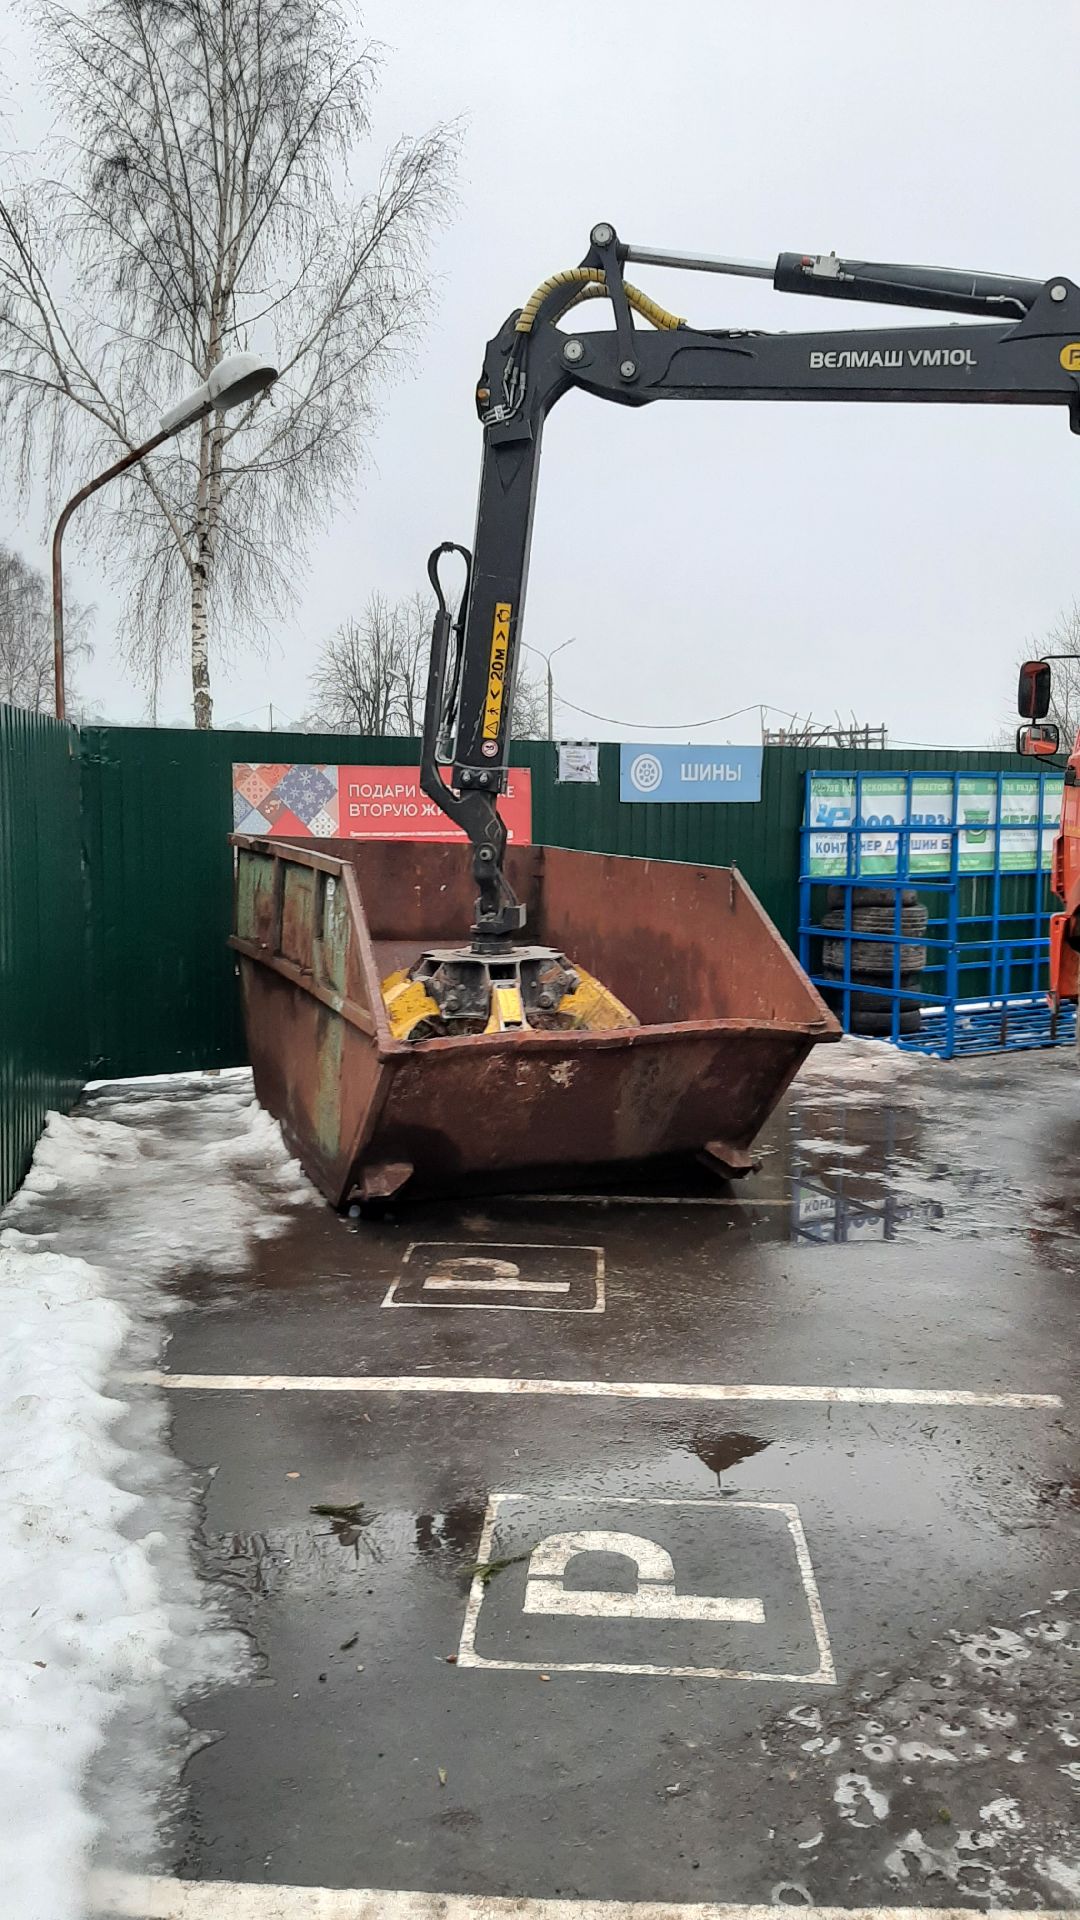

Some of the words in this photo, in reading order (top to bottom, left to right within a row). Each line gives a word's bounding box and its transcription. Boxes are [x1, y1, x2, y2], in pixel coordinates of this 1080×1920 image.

[810, 350, 903, 369] ВЕЛМАШ
[908, 349, 977, 366] VM10L
[680, 763, 742, 782] ШИНЫ
[349, 784, 416, 799] ПОДАРИ
[349, 803, 418, 817] ВТОРУЮ
